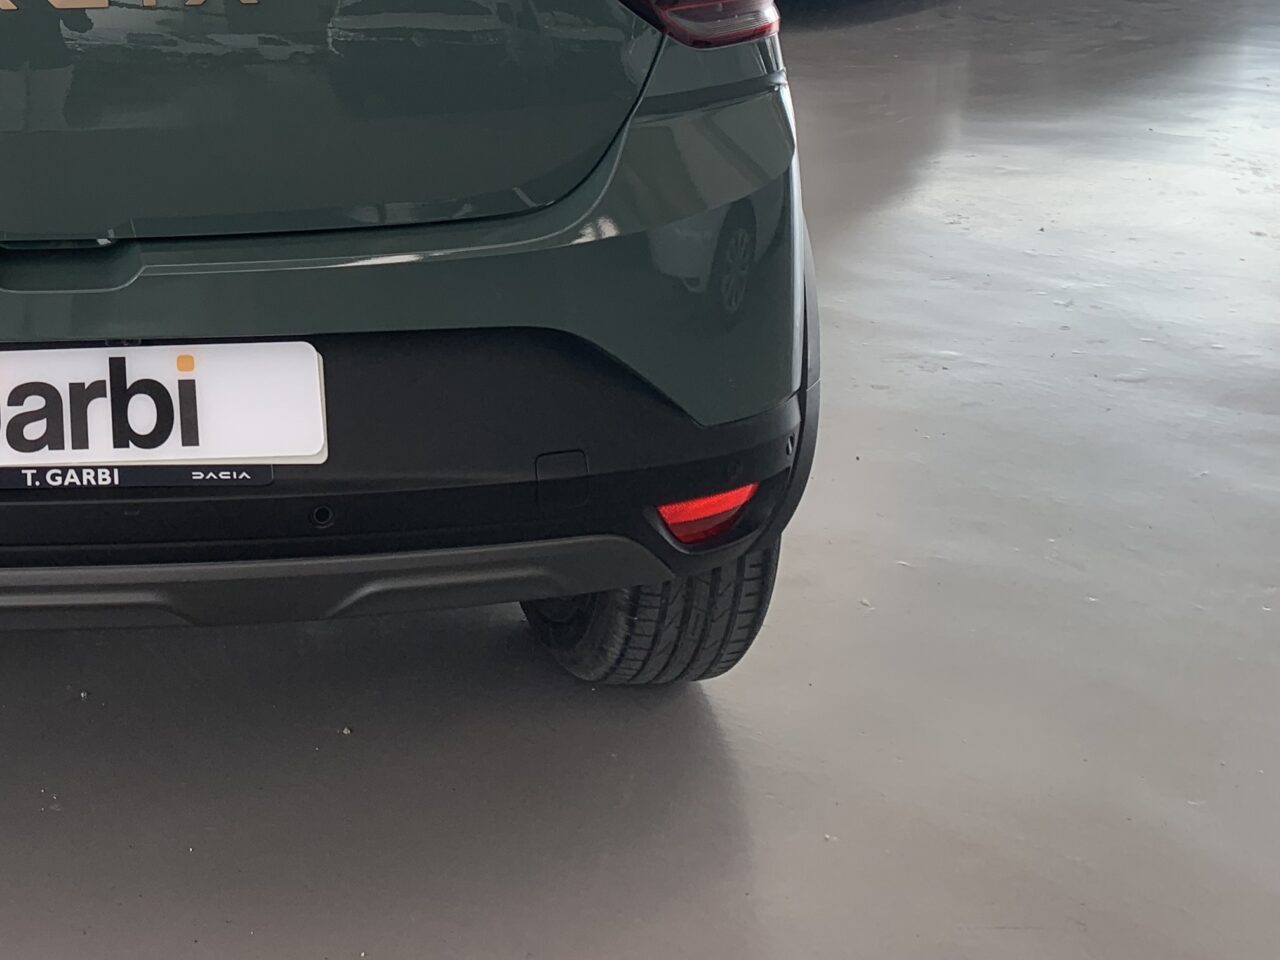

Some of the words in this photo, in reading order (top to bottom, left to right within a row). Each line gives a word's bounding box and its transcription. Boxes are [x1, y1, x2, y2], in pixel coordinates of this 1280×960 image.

[21, 469, 40, 486] T.
[45, 468, 119, 486] GARBI
[191, 471, 251, 480] DACIA
